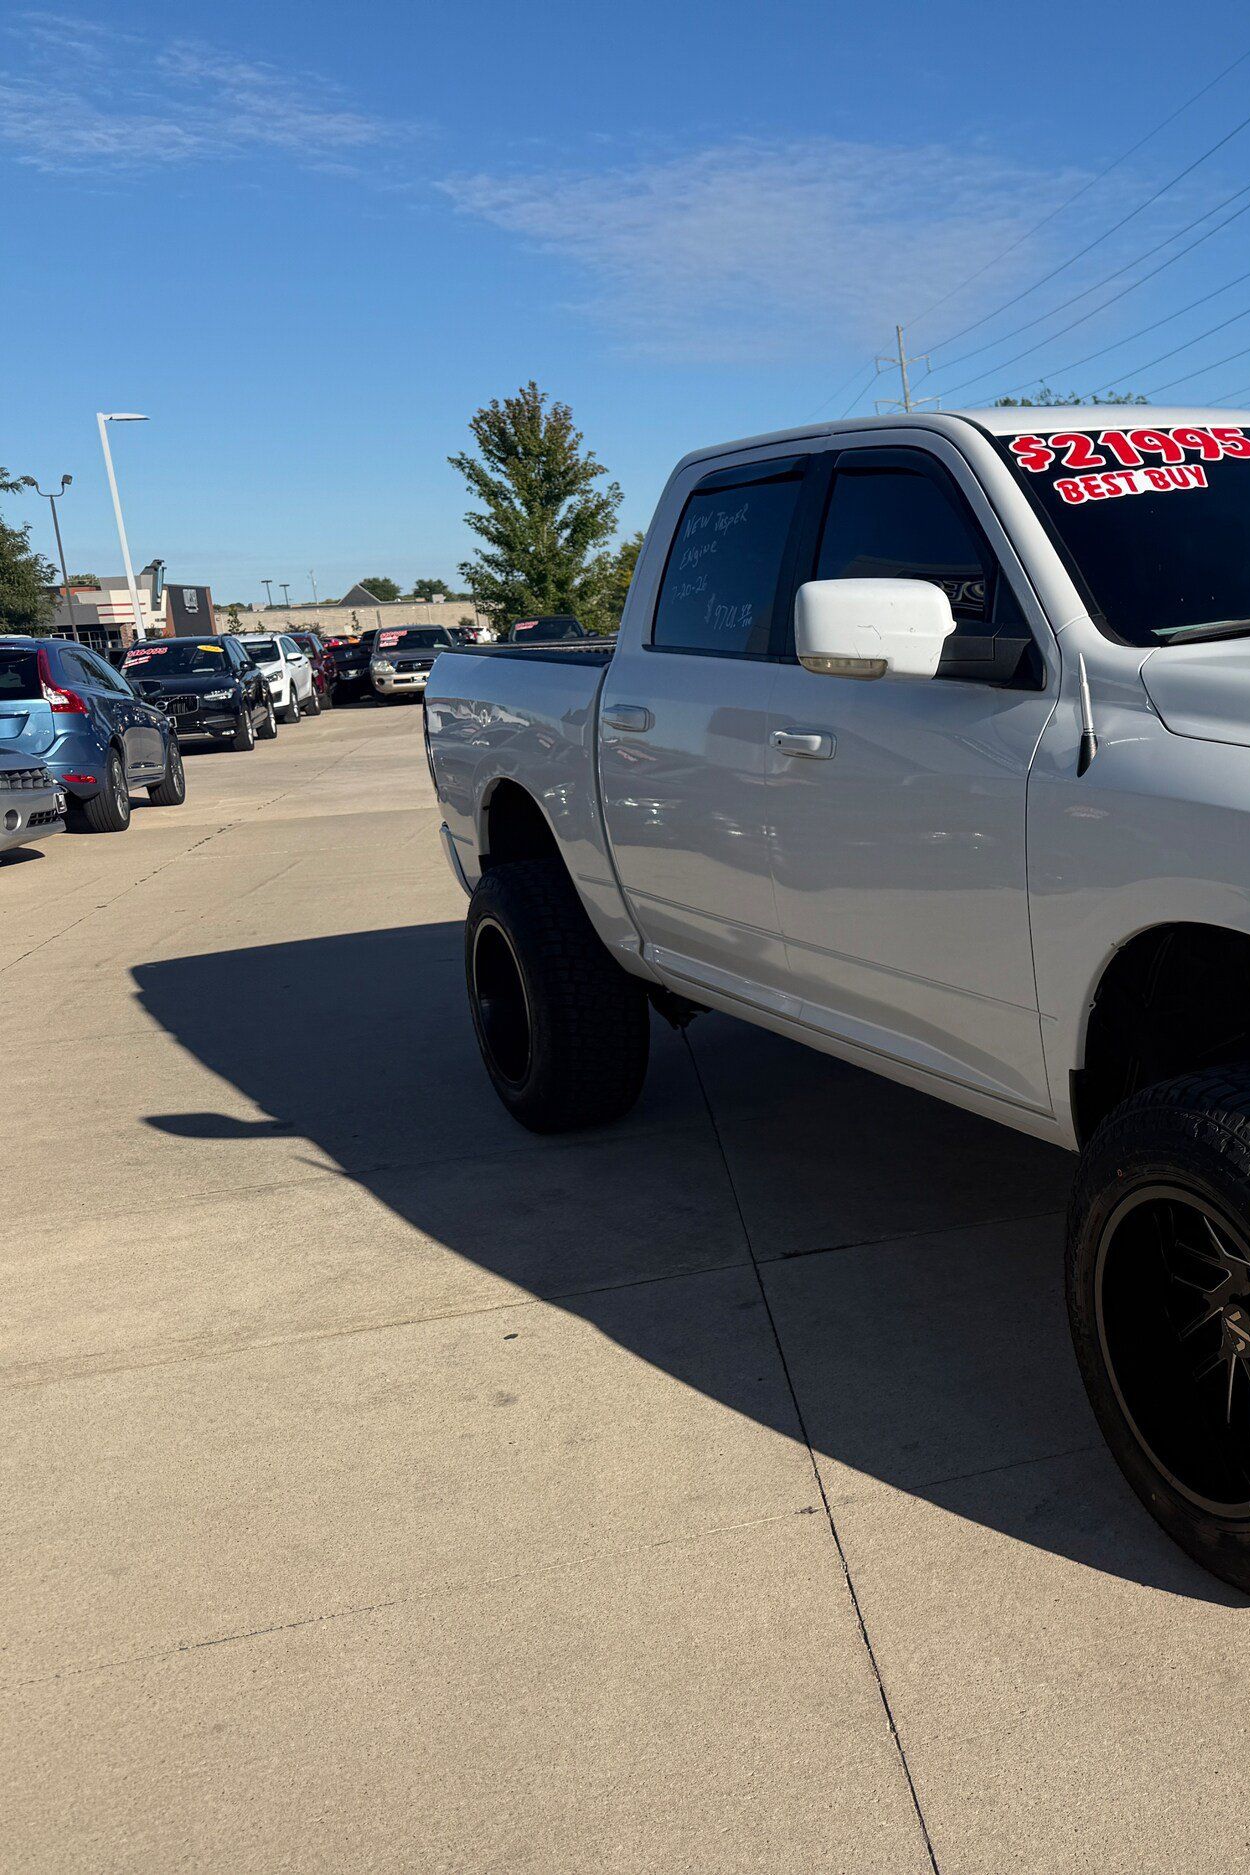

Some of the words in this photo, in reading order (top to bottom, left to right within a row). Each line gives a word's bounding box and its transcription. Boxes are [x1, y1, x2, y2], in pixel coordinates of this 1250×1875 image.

[1054, 470, 1136, 504] BEST
[1142, 465, 1208, 492] BUY
[683, 511, 713, 541] NEW
